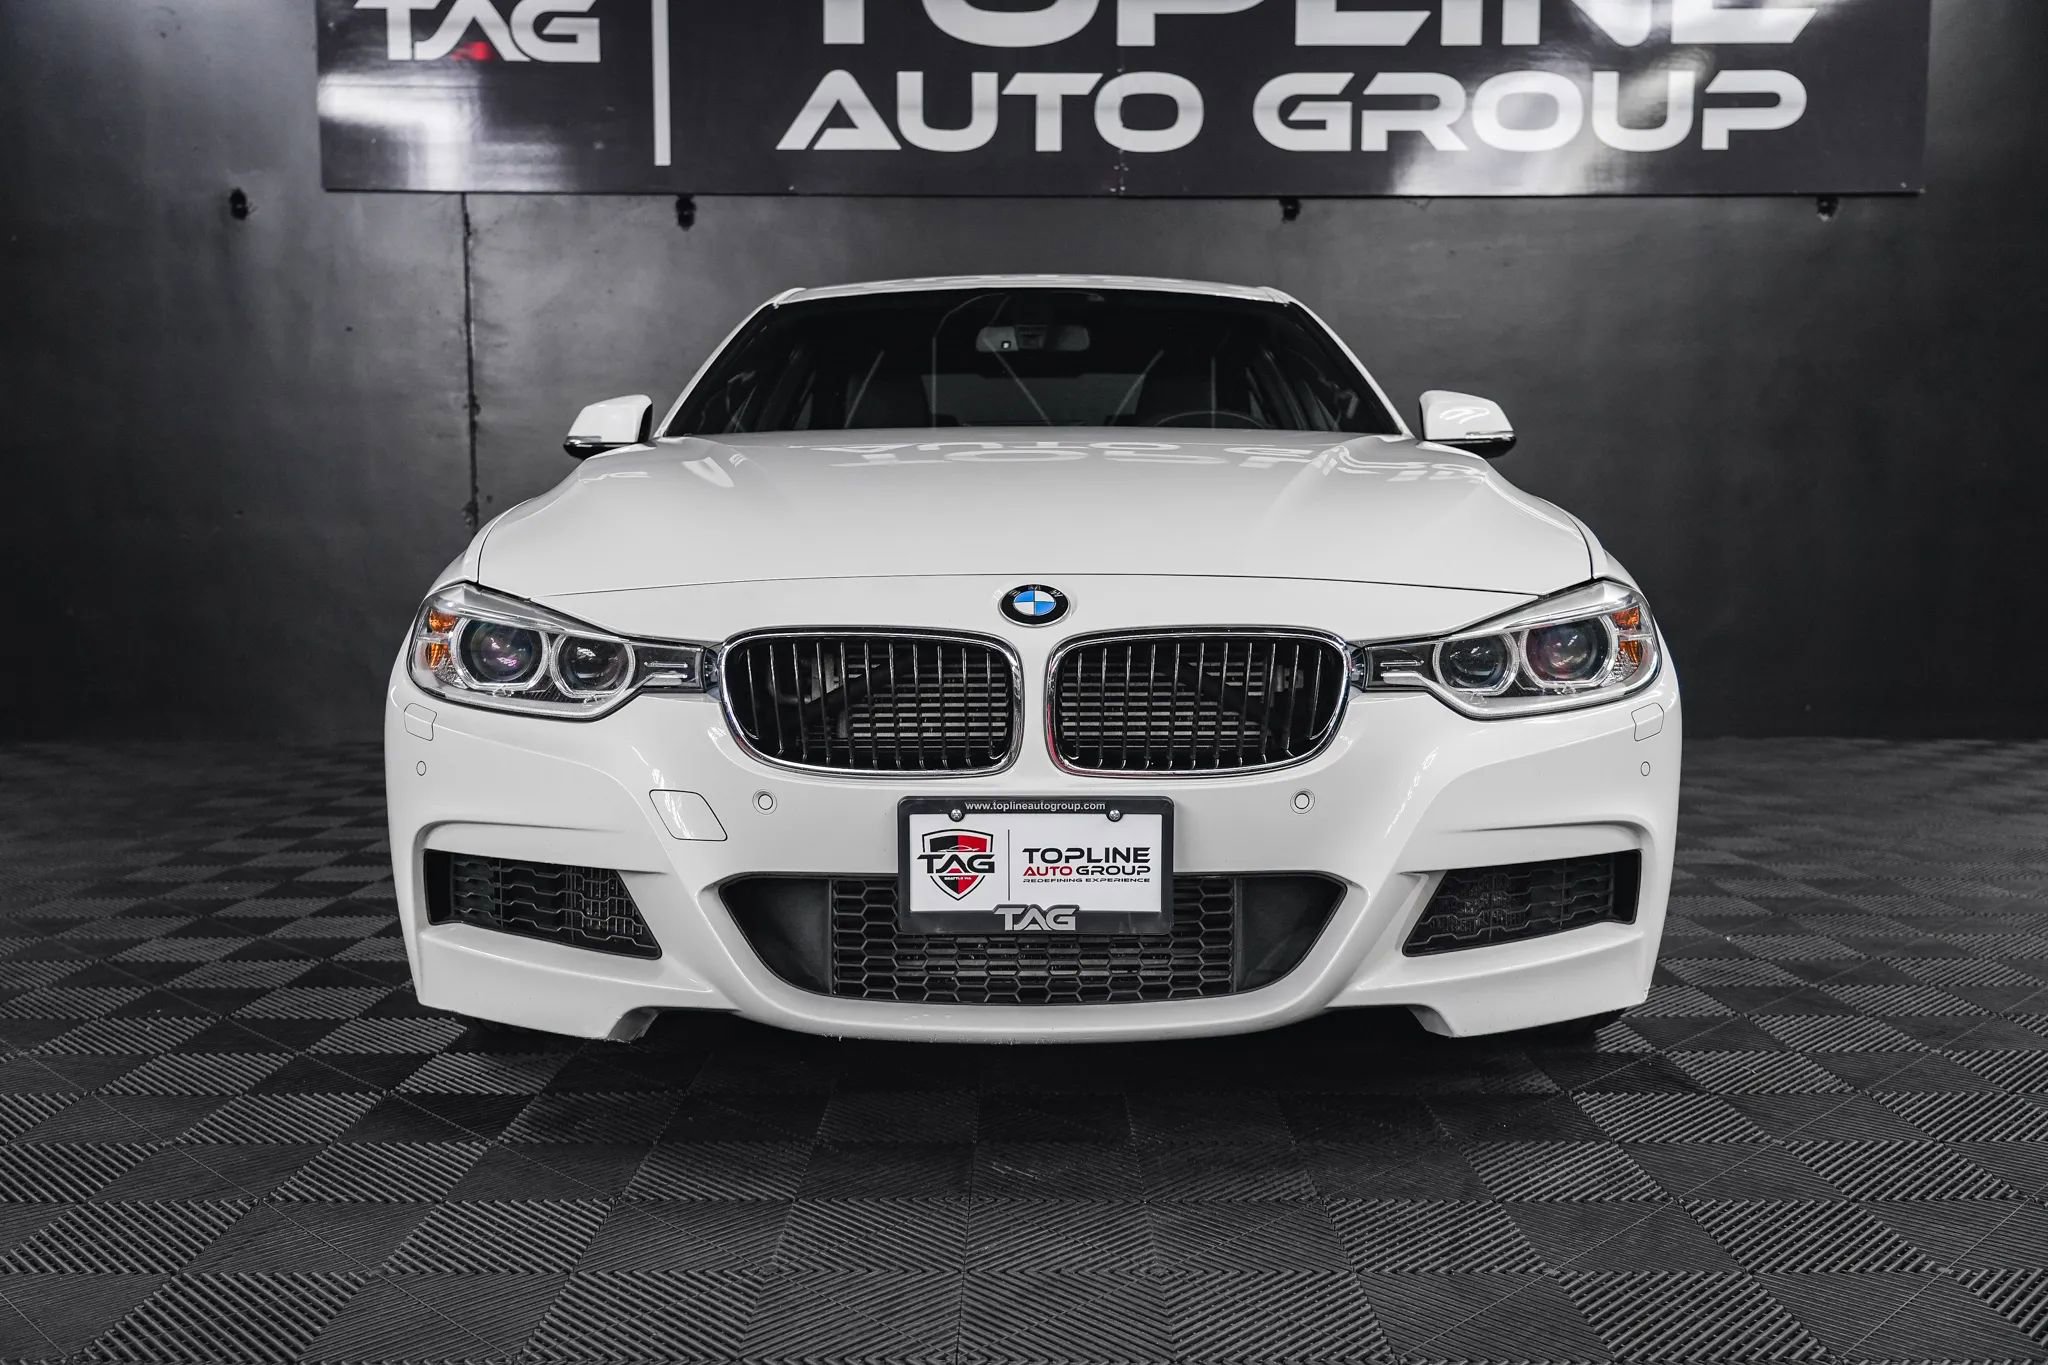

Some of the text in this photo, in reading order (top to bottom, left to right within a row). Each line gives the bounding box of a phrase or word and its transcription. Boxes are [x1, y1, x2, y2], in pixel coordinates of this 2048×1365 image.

[353, 0, 601, 63] TAG
[774, 69, 1808, 153] AUTO GROUP
[964, 801, 1106, 812] www.toplineautogroup.com
[917, 853, 996, 874] TAG
[1022, 847, 1152, 864] TOPLINE
[1023, 865, 1151, 876] AUTO GROUP
[993, 906, 1077, 932] TAG
